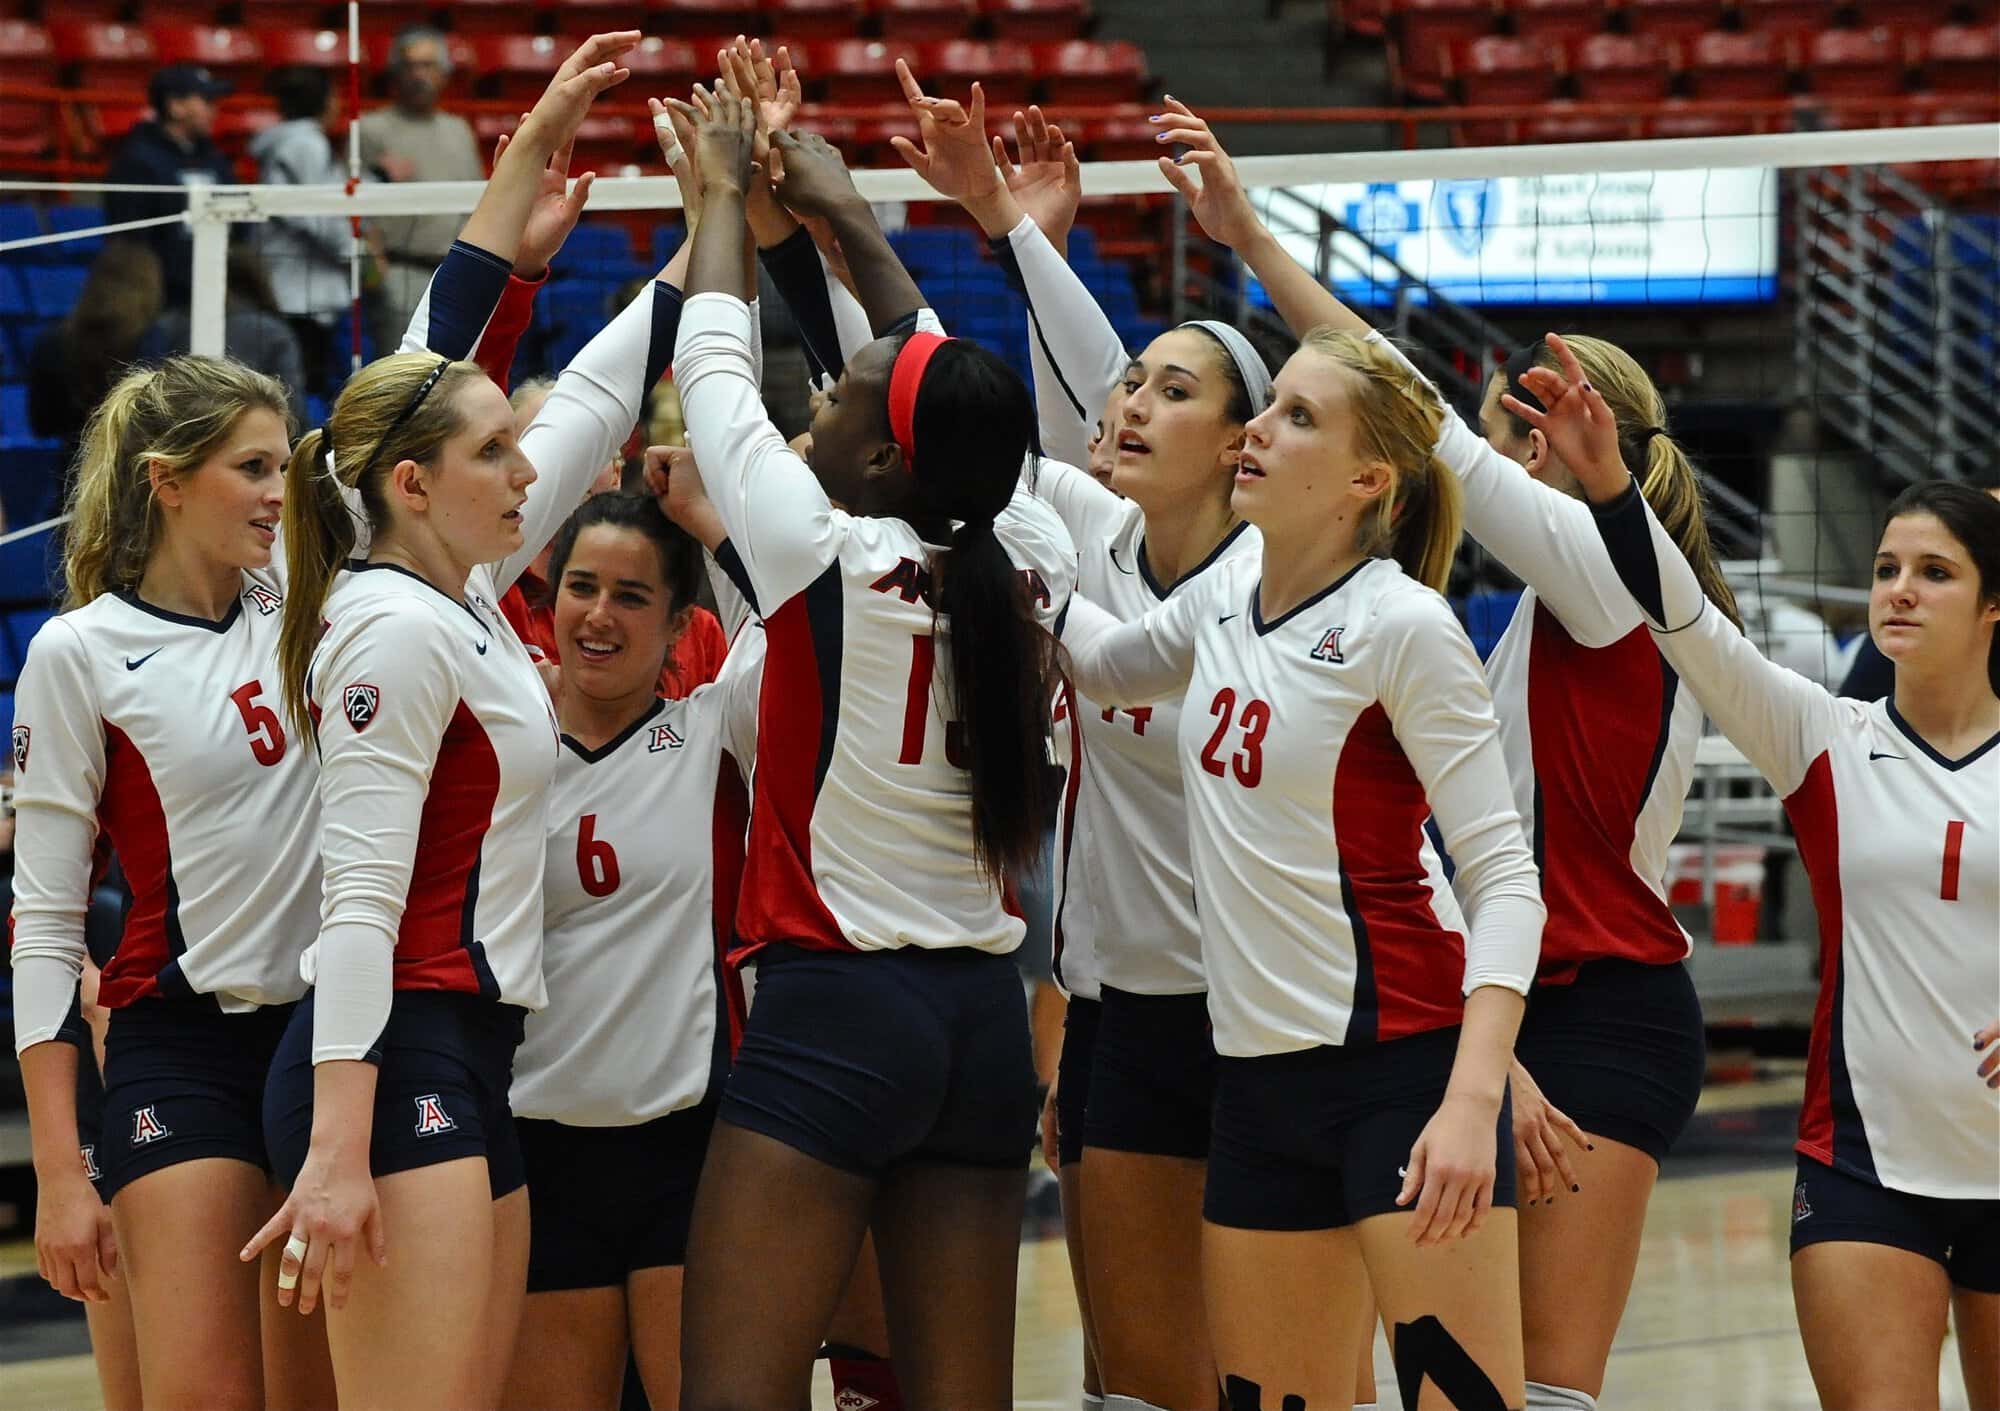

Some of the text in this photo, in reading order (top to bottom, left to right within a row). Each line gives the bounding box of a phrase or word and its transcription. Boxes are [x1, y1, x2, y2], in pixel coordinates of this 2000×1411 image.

[243, 585, 282, 616] A
[1310, 628, 1344, 664] A
[346, 687, 377, 712] PAC
[351, 705, 369, 721] 12
[230, 680, 286, 767] 5
[648, 724, 685, 752] A
[1201, 687, 1271, 789] 23
[577, 814, 621, 897] 6
[1940, 820, 1965, 901] 1
[132, 1105, 167, 1148] A
[415, 1094, 455, 1137] A
[840, 1397, 864, 1407] PRO
